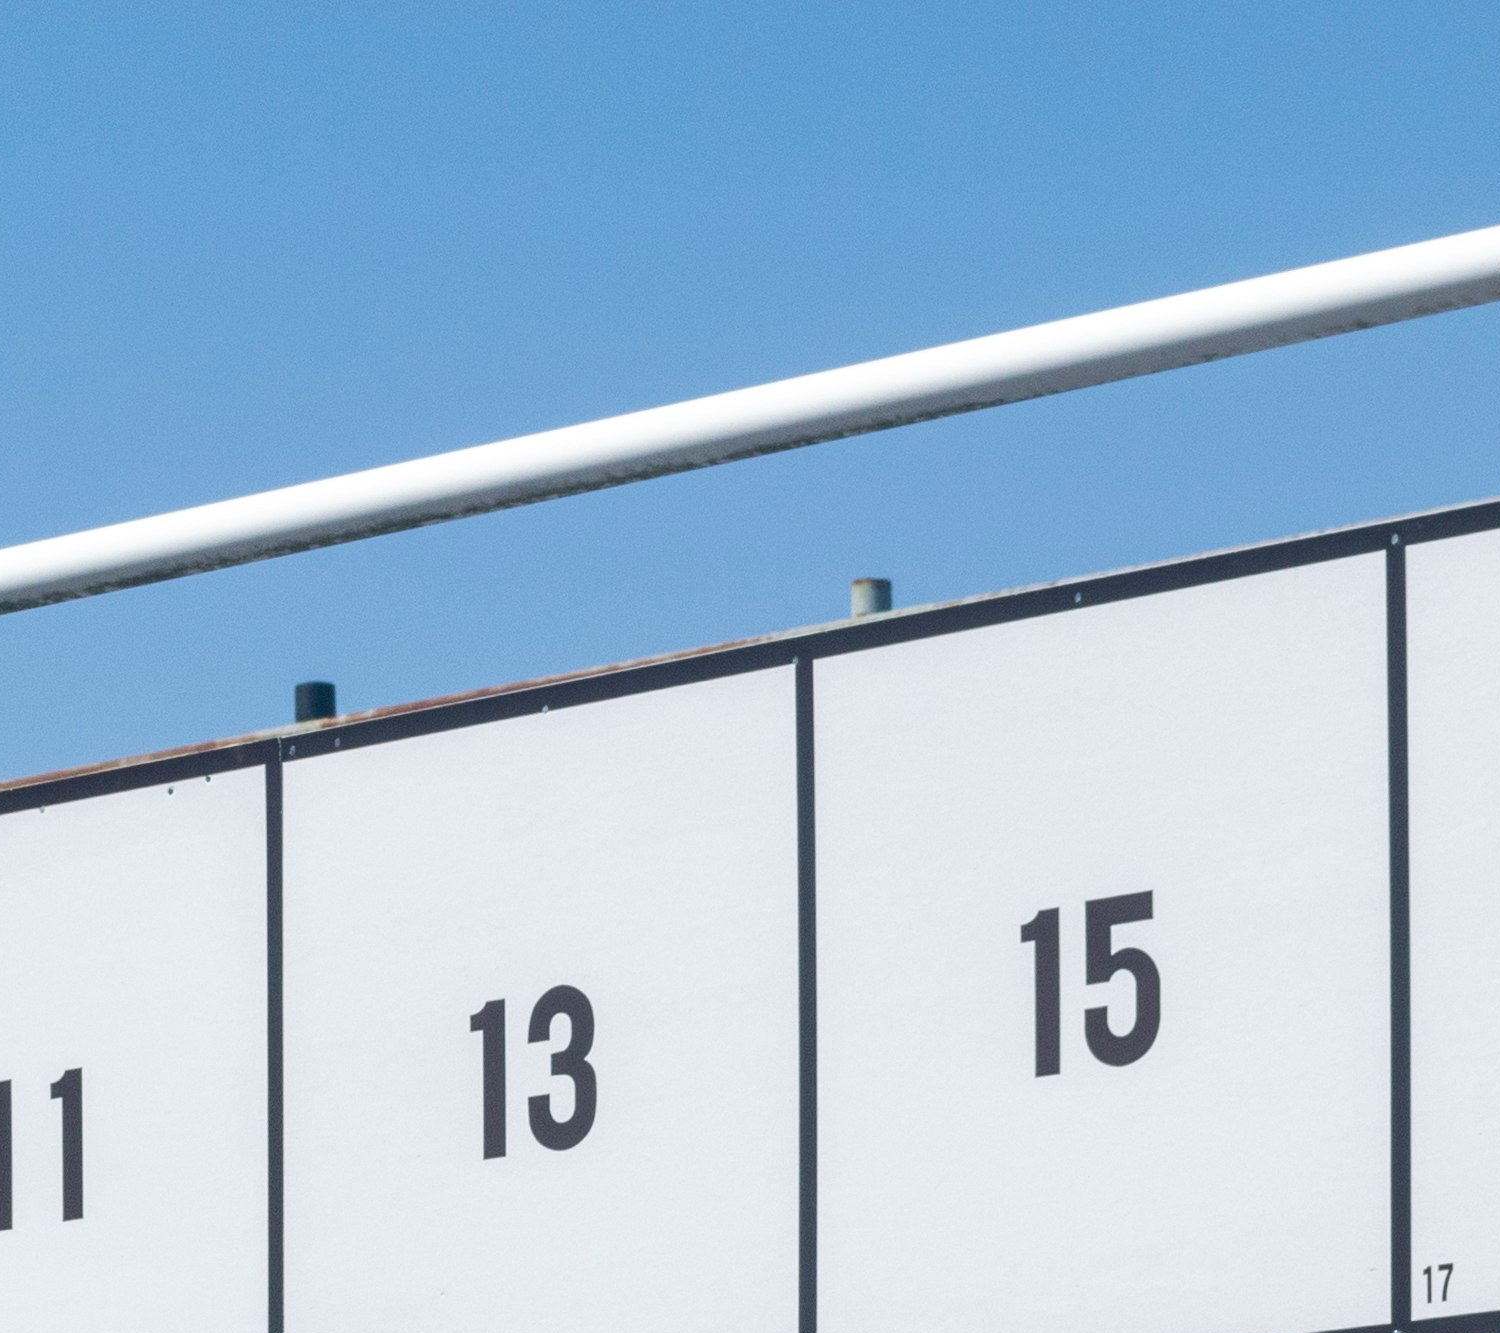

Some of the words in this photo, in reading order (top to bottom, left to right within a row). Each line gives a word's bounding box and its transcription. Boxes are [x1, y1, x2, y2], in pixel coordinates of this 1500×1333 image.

[1021, 890, 1161, 1077] 15
[470, 985, 597, 1160] 13
[1422, 1262, 1454, 1304] 17
